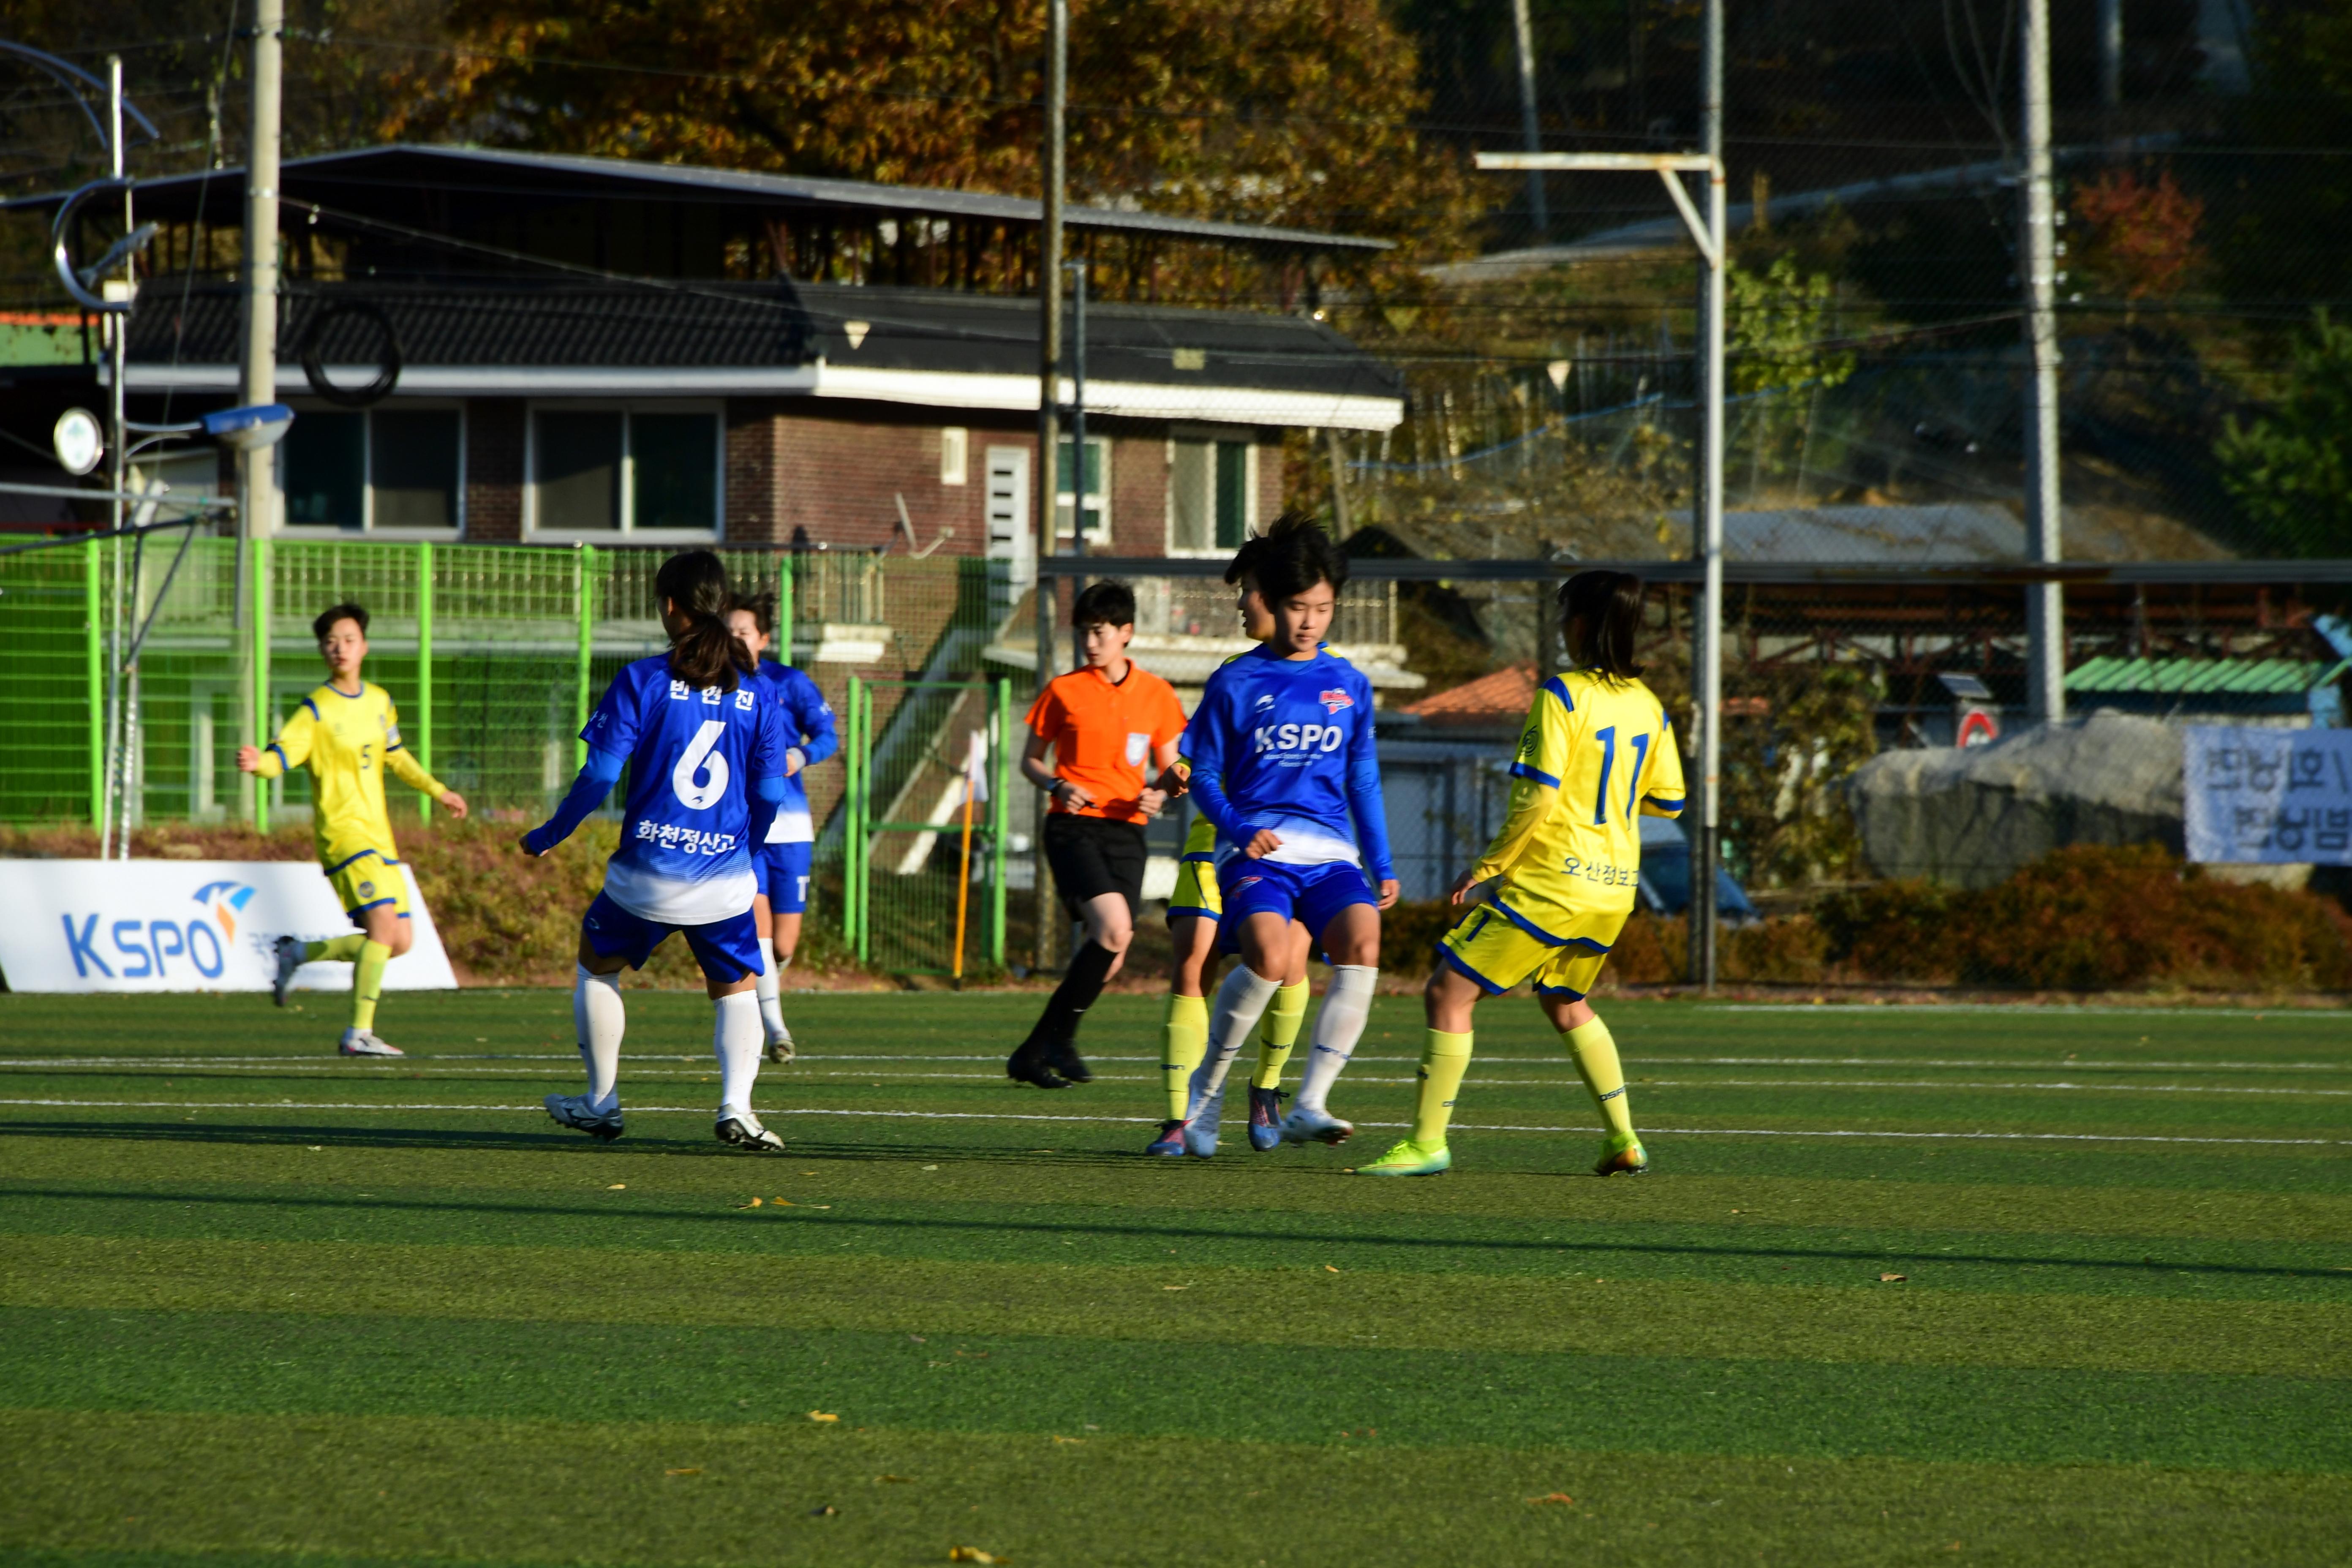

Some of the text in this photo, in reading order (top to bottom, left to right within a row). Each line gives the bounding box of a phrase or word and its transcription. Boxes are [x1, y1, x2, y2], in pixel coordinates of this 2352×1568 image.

[360, 743, 372, 769] 5
[1255, 724, 1343, 753] KSPO
[672, 719, 730, 810] 6
[1595, 725, 1649, 831] 11
[636, 820, 737, 856] 화천정산고
[62, 913, 223, 978] KSPO
